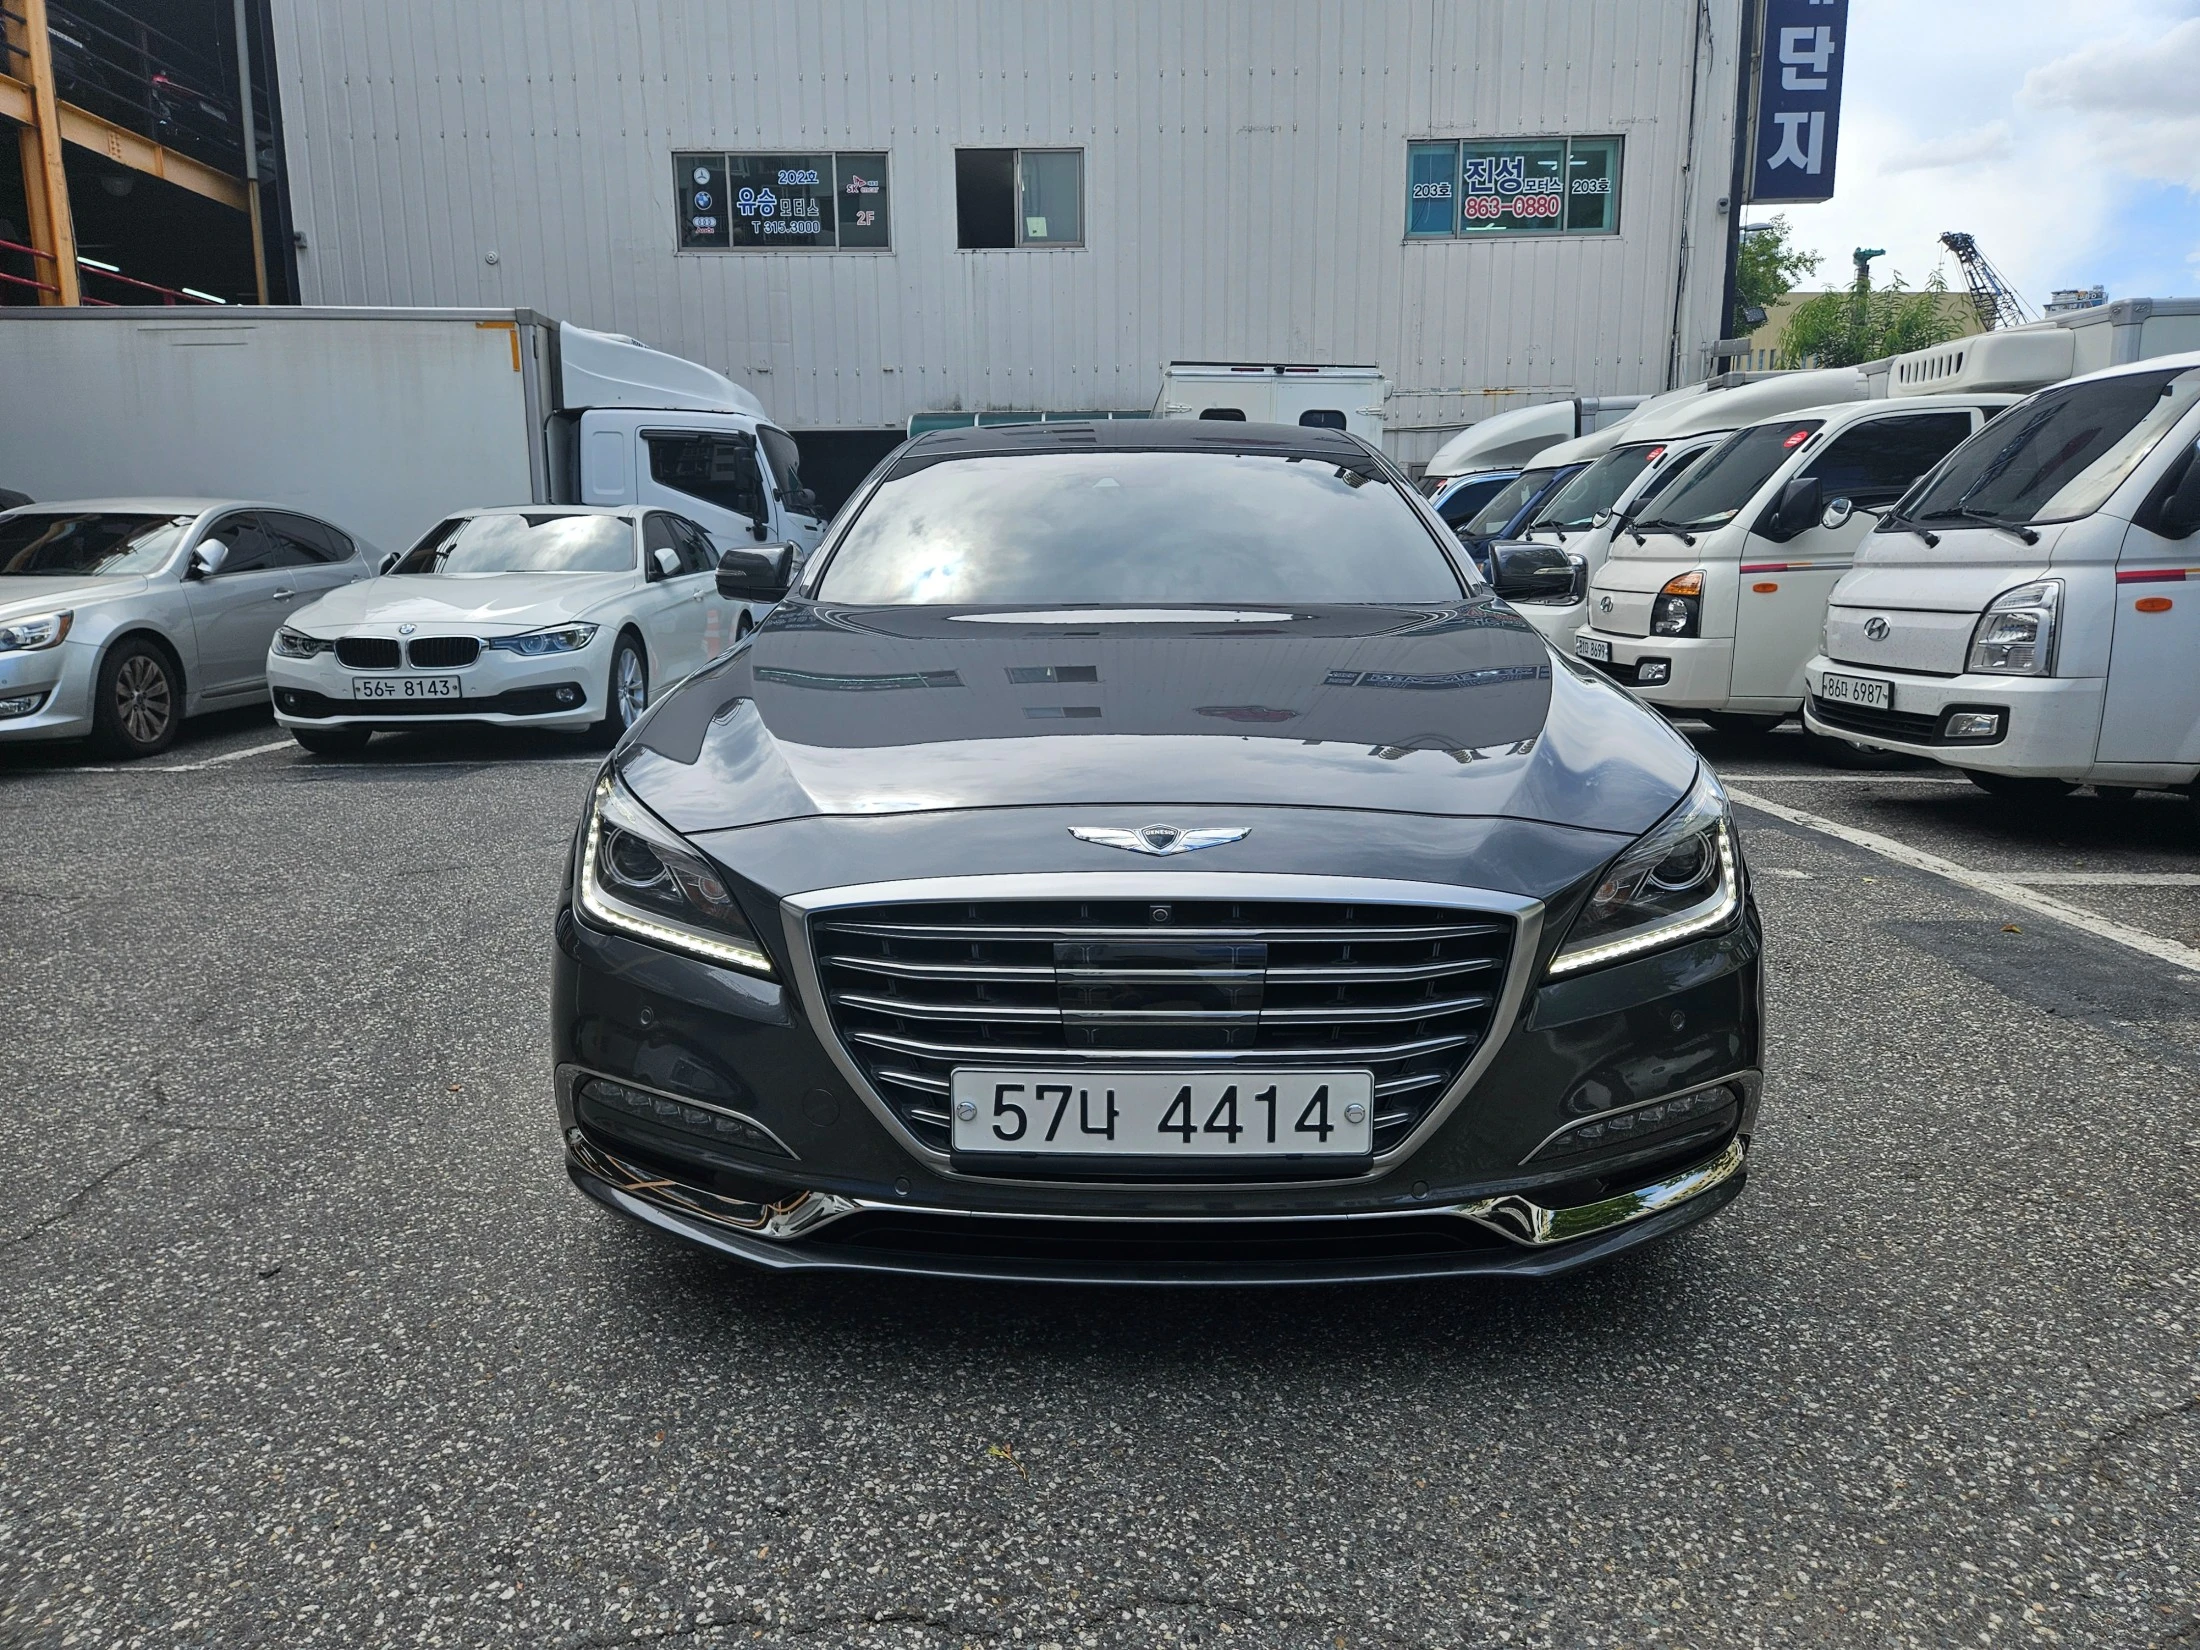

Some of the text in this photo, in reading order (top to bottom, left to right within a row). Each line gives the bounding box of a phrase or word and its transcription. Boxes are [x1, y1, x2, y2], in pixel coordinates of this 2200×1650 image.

[1766, 0, 1835, 174] 단지
[778, 170, 819, 185] 202호
[1465, 156, 1563, 194] 진성 모터스
[846, 184, 859, 193] SK
[1413, 182, 1451, 198] 203호
[1572, 178, 1610, 194] 203호
[737, 187, 819, 217] 유승 모터스
[1465, 195, 1560, 219] 863-0880
[856, 210, 875, 226] 2F
[752, 220, 820, 234] T 315.3000
[363, 680, 450, 697] 56누 8143
[1828, 678, 1882, 703] 86마 6987
[992, 1084, 1334, 1143] 57나 4414
